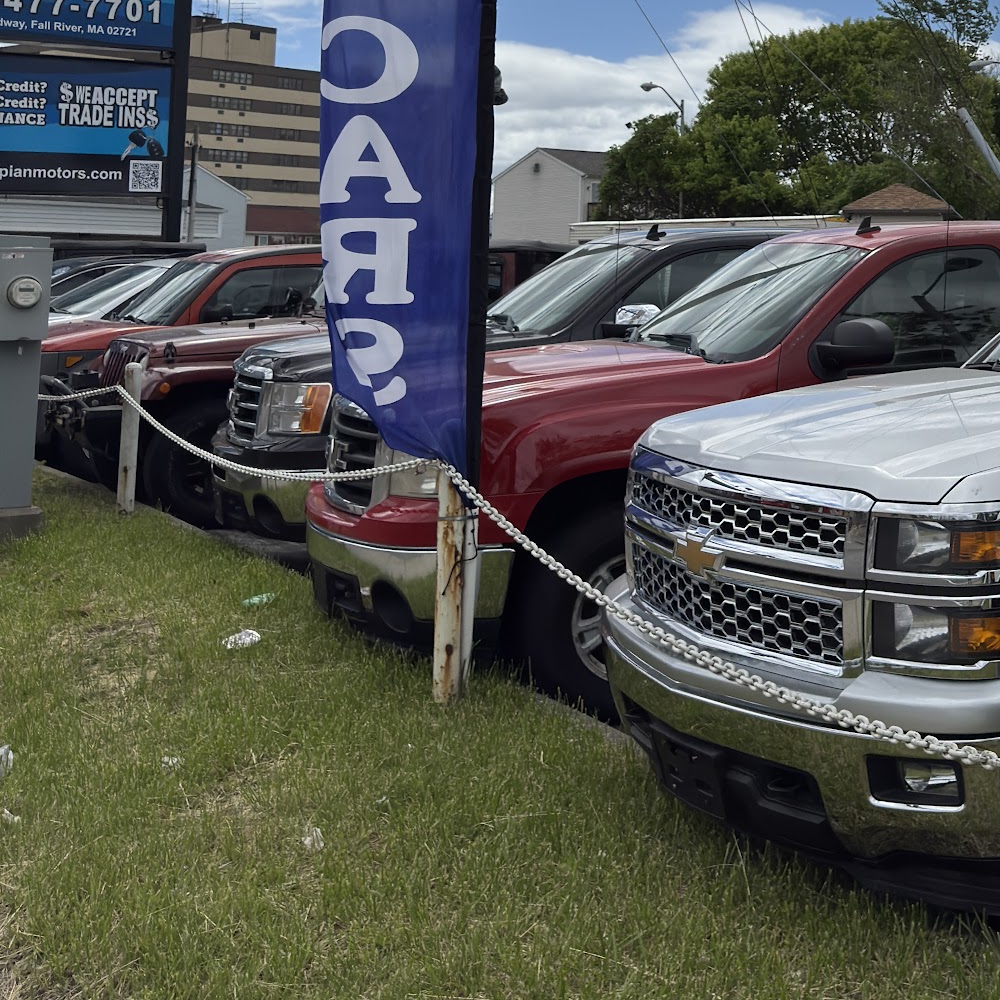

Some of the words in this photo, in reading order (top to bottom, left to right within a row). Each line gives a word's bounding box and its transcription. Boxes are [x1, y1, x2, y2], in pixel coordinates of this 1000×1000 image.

[31, 19, 51, 30] Fall
[53, 21, 84, 34] River,
[87, 25, 105, 35] MA
[106, 26, 137, 37] 02721
[90, 86, 158, 108] ACCEPT
[58, 103, 114, 127] TRADE
[0, 165, 123, 181] pianmotors.com
